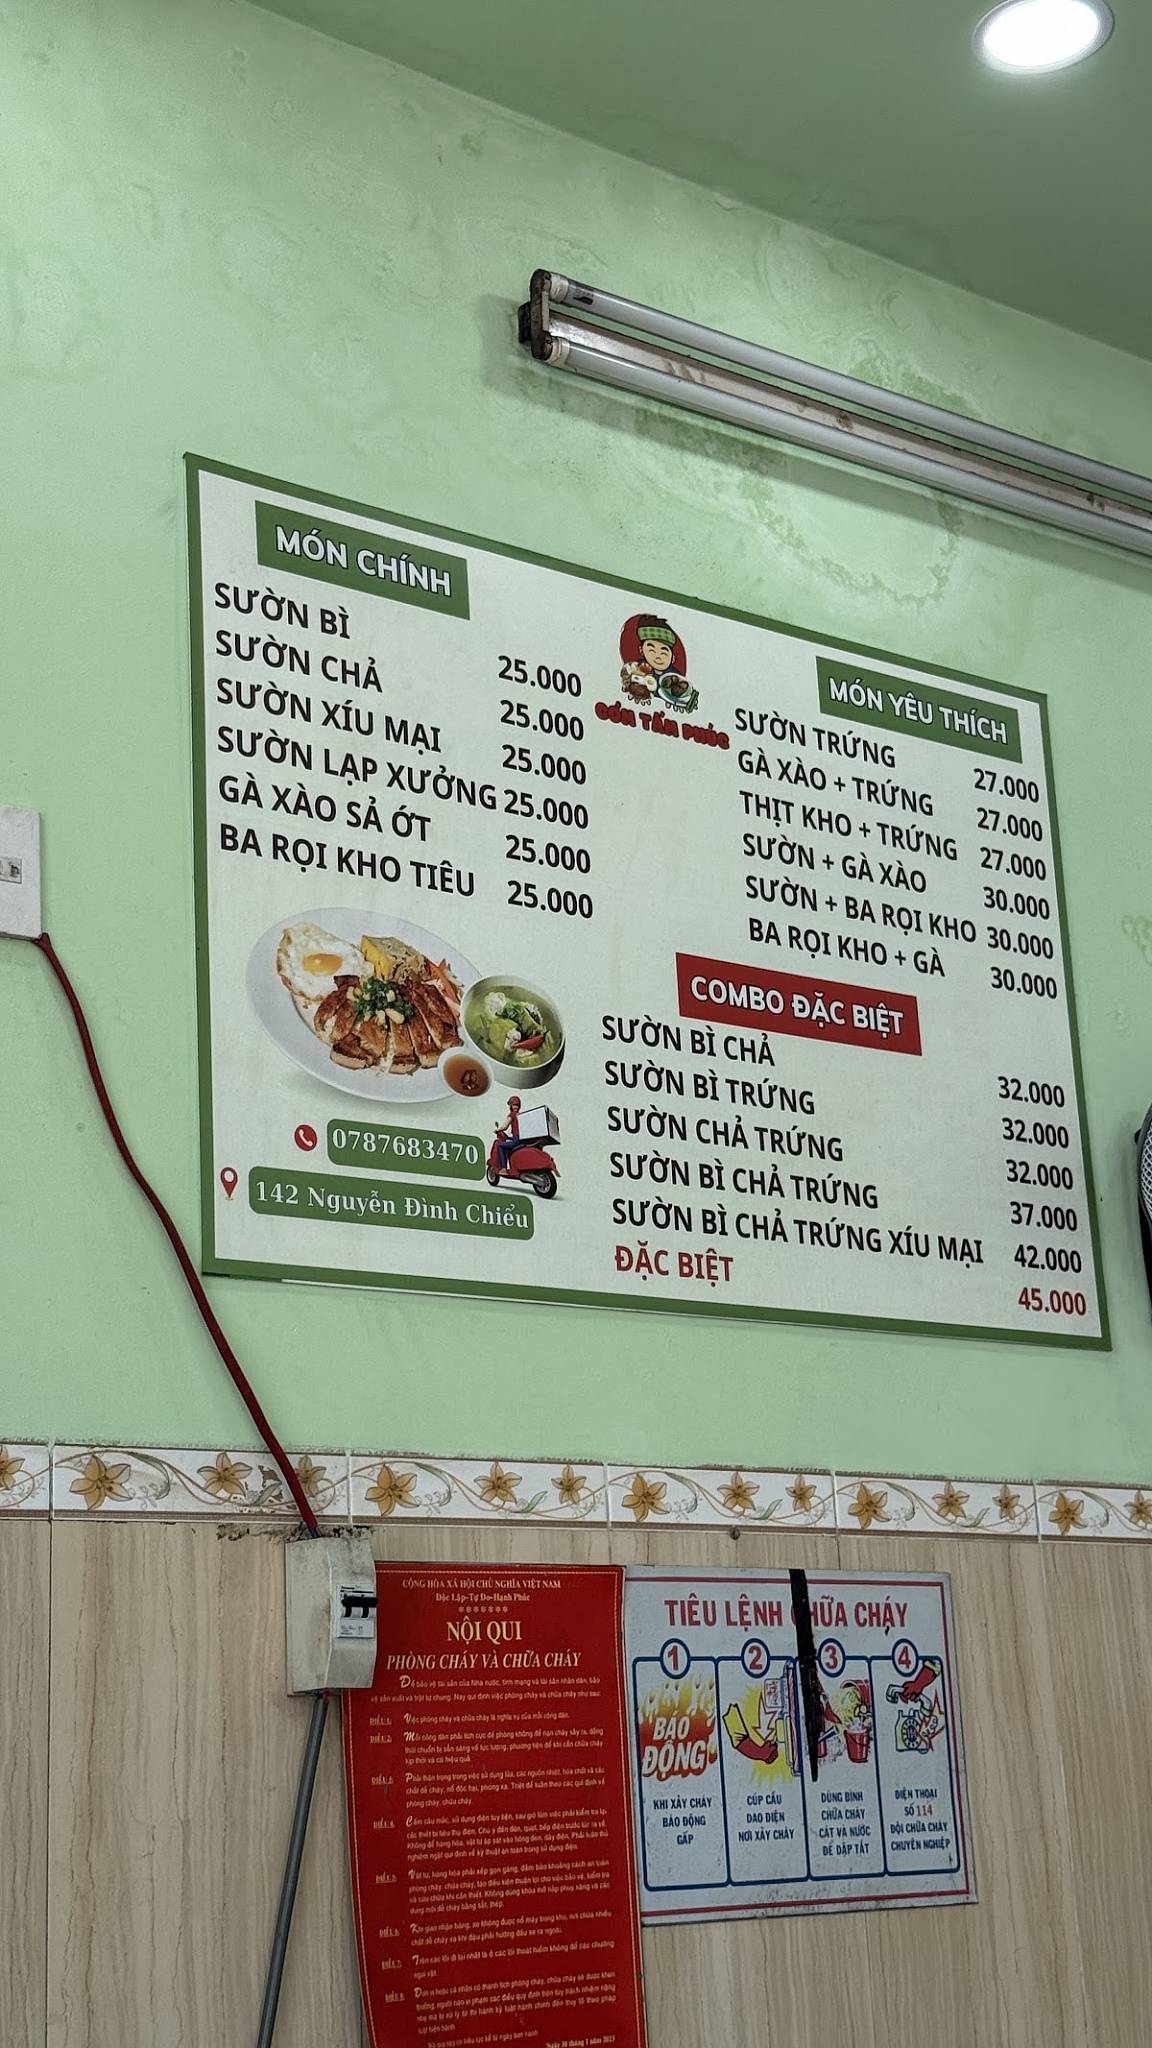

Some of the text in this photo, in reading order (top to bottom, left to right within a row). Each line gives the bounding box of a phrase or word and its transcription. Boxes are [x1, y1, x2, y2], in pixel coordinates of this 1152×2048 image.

[277, 527, 450, 596] MÓN CHÍNH
[215, 583, 350, 639] SƯỜN BÌ
[216, 630, 382, 693] SƯỜN CHẢ
[498, 656, 581, 697] 25.000
[218, 678, 441, 755] SƯỜN XÍU MẠI
[500, 700, 584, 740] 25.000
[830, 678, 1006, 743] MÓN YÊU THÍCH
[735, 708, 895, 768] SƯỜN TRỨNG
[218, 726, 496, 809] SƯỜN LẠP XƯỞNG
[502, 744, 586, 784] 25.000
[738, 748, 933, 816] GÀ XÀO + TRỨNG
[974, 768, 1039, 802] 27.000
[220, 772, 430, 841] GÀ XÀO SẢ ỚT
[504, 790, 588, 829] 25.000
[740, 790, 957, 860] THỊT KHO + TRỨNG
[977, 808, 1042, 841] 27.000
[221, 824, 474, 896] BA RỌI KHO TIÊU
[506, 835, 590, 873] 25.000
[743, 833, 926, 892] SƯỜN + GÀ XÀO
[980, 847, 1046, 880] 27.000
[508, 880, 592, 918] 25.000
[746, 876, 976, 942] SƯỜN + BA RỌI KHO
[984, 887, 1050, 920] 30.000
[749, 918, 945, 976] BA RỌI KHO + GÀ
[987, 927, 1053, 959] 30.000
[991, 967, 1057, 999] 30.000
[692, 977, 903, 1038] COMBO ĐẶC BIỆT
[602, 1015, 775, 1066] SƯỜN BÌ CHẢ
[605, 1060, 814, 1114] SƯỜN BÌ TRỨNG
[998, 1076, 1064, 1107] 32.000
[333, 1129, 478, 1164] 0787683470
[608, 1104, 842, 1161] SƯỜN CHẢ TRỨNG
[1002, 1118, 1068, 1148] 32.000
[610, 1150, 878, 1208] SƯỜN BÌ CHẢ TRỨNG
[1006, 1160, 1073, 1190] 32.000
[257, 1182, 528, 1228] 142 Nguyễn Đình Chiểu
[1010, 1202, 1077, 1231] 37.000
[613, 1196, 984, 1268] SƯỜN BÌ CHẢ TRỨNG XÍU MẠI
[615, 1240, 733, 1287] ĐẶC BIỆT
[1014, 1244, 1081, 1273] 42.000
[1018, 1288, 1086, 1315] 45.000
[542, 1580, 561, 1589] NAM
[447, 1616, 522, 1645] NỘI QUI
[665, 1593, 908, 1632] TIÊU LỆNH HỮA CHÁY
[386, 1649, 581, 1670] PHÒNG CHÁY VÀ CHỮA CHÁY
[667, 1646, 678, 1670] 1
[749, 1646, 762, 1670] 2
[825, 1646, 838, 1669] 3
[898, 1647, 911, 1668] 4
[653, 1710, 689, 1740] BÁO
[642, 1740, 705, 1778] ĐỘNG
[653, 1799, 668, 1810] KHI
[747, 1813, 763, 1823] DAO
[916, 1805, 933, 1816] 114
